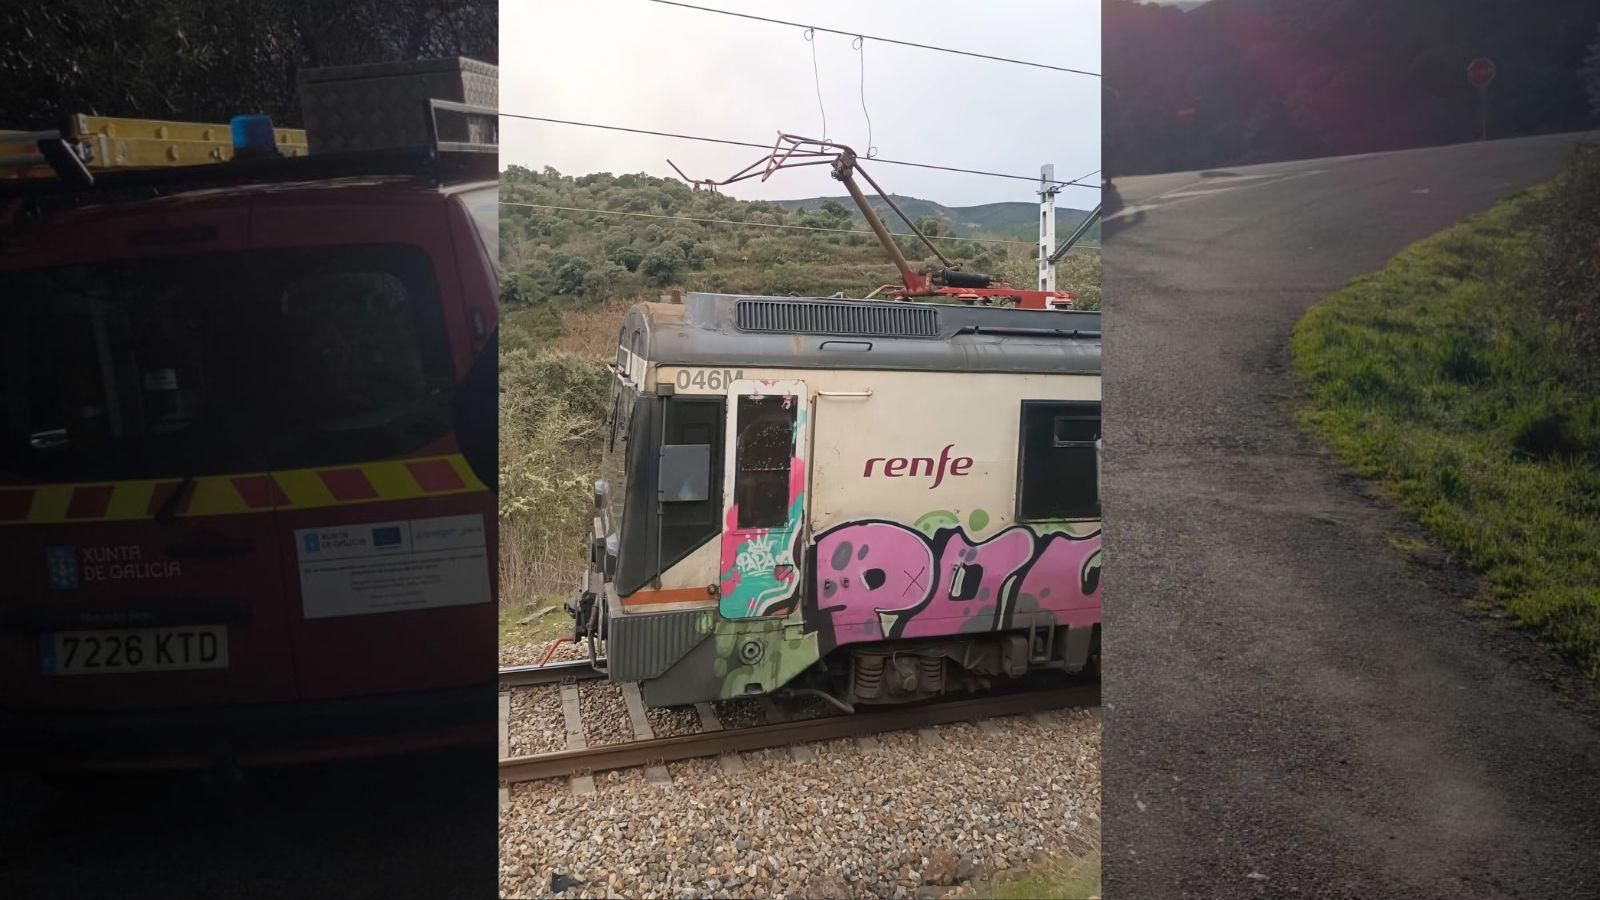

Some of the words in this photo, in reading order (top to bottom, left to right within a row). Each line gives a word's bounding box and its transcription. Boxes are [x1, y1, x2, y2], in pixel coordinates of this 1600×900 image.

[863, 444, 974, 490] renfe
[82, 545, 141, 563] XUNTA
[84, 565, 107, 582] DE
[110, 560, 182, 579] GALICIA
[62, 636, 143, 669] 7226
[157, 632, 218, 664] KTD
